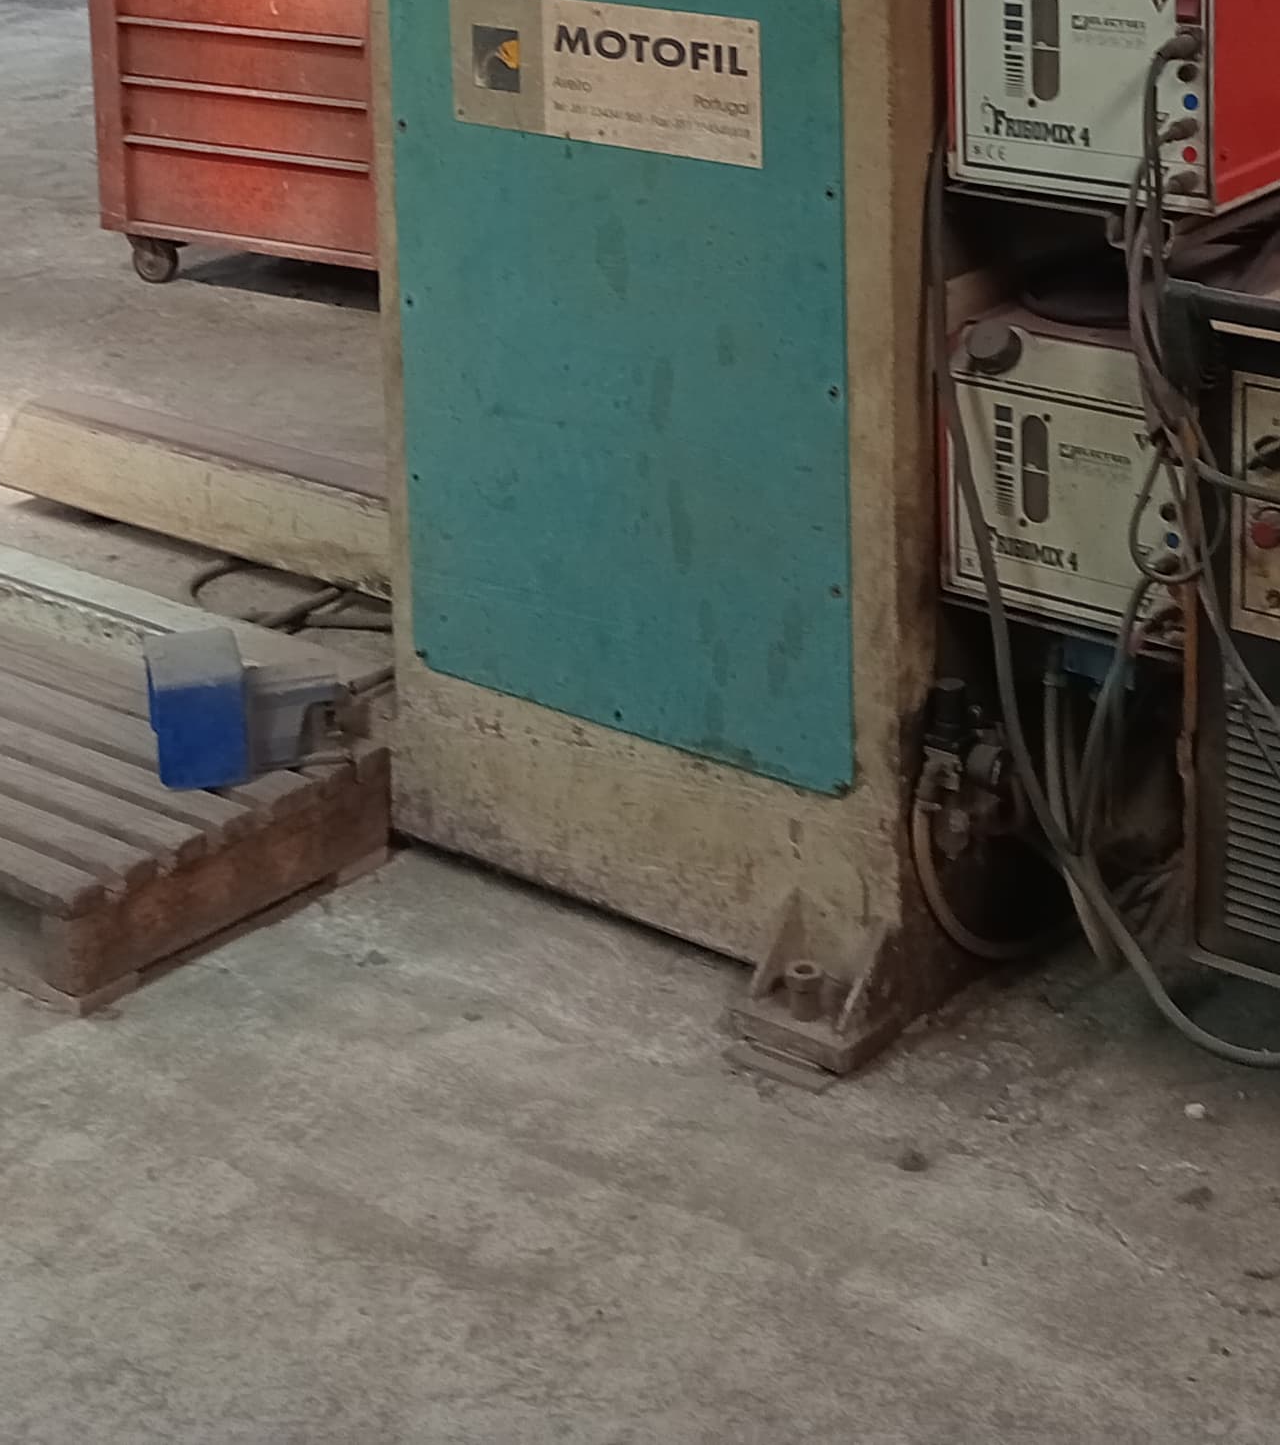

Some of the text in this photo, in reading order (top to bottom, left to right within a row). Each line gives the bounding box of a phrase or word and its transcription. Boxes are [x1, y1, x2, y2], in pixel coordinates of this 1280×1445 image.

[554, 24, 749, 77] MOTOFIL
[693, 93, 749, 118] Portugal
[1080, 127, 1091, 147] 4
[1068, 551, 1078, 572] 4
